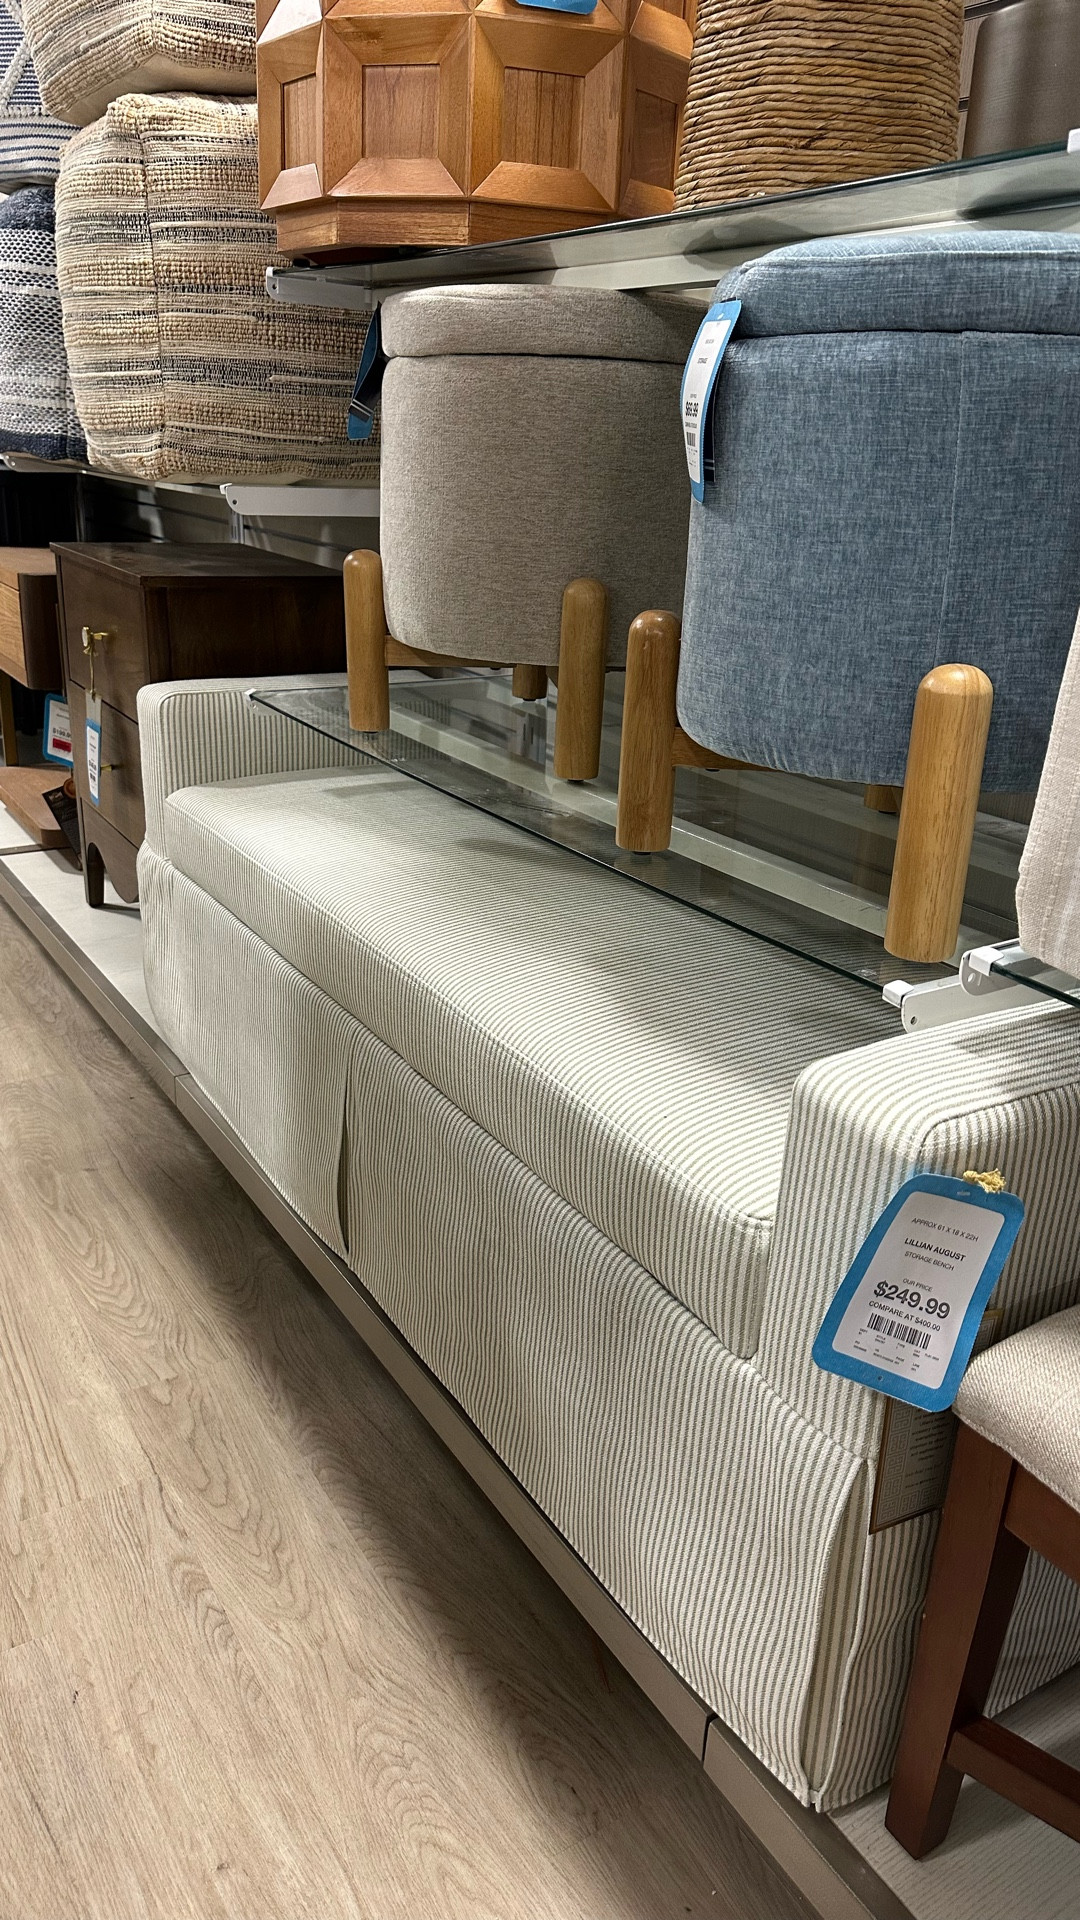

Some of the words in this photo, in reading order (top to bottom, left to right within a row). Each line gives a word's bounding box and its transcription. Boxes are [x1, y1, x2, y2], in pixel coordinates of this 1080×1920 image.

[911, 1217, 937, 1230] APPROX
[937, 1224, 945, 1232] 61
[965, 1233, 979, 1242] 22H
[904, 1237, 933, 1251] LILLIAN
[934, 1246, 967, 1262] AUGUST
[904, 1251, 933, 1264] STORAGE
[932, 1259, 955, 1271] BENCH
[902, 1278, 916, 1286] OUR
[915, 1282, 934, 1292] PRICE
[873, 1280, 951, 1319] $249.99
[868, 1300, 904, 1318] COMPARE
[904, 1313, 914, 1321] AT
[914, 1317, 941, 1332] $400.00
